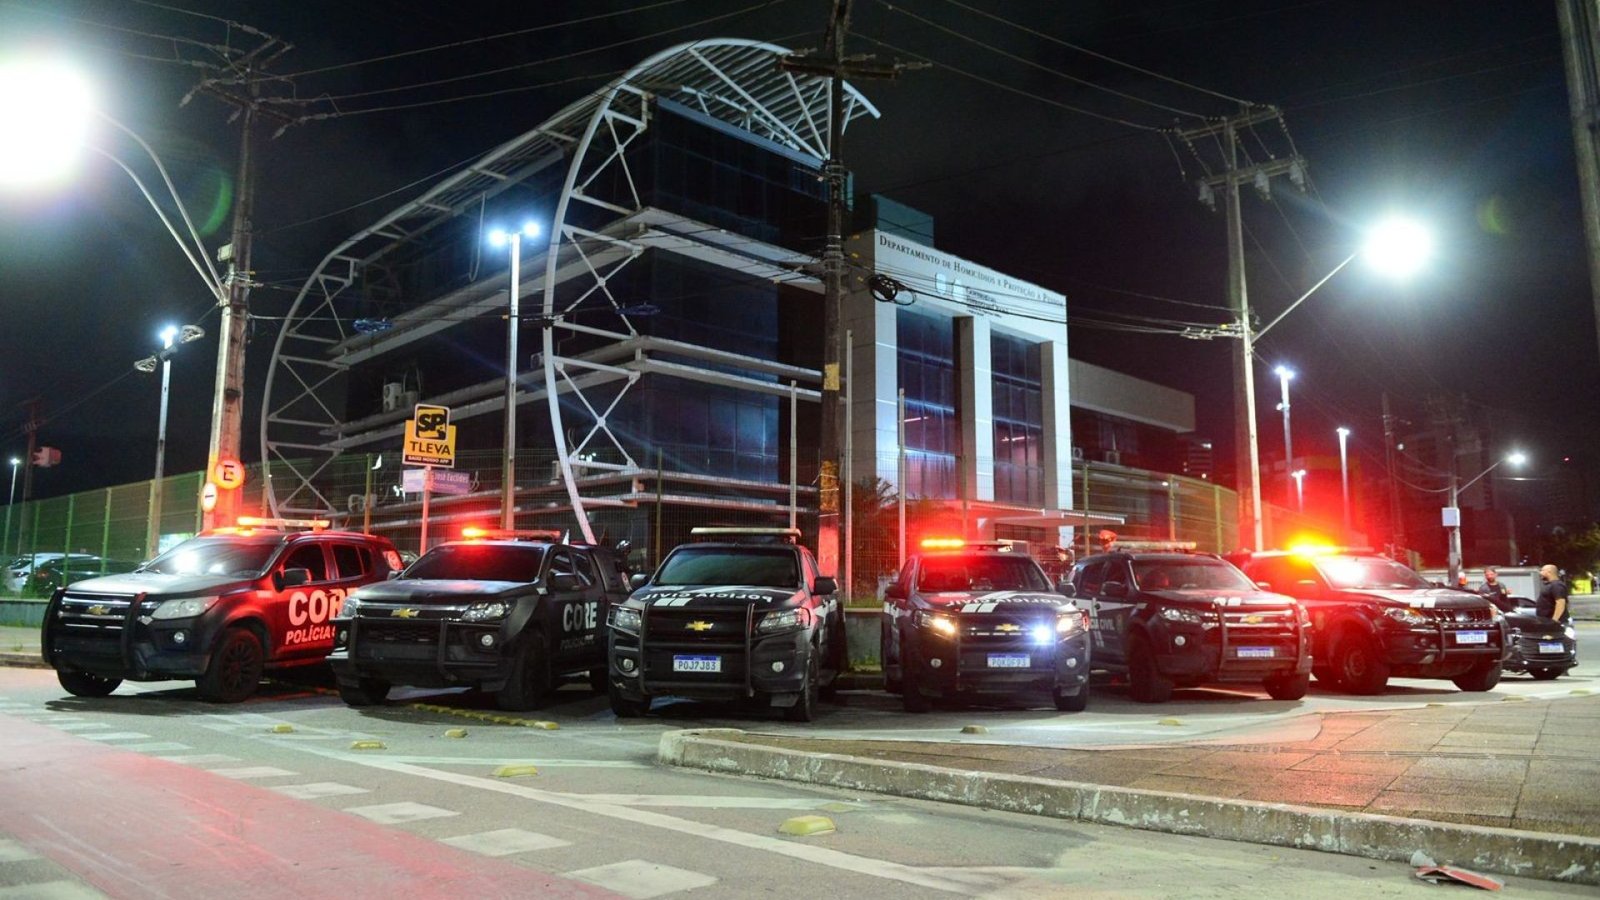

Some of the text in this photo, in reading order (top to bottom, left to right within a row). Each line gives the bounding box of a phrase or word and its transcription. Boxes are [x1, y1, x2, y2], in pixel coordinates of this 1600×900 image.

[879, 235, 940, 266] DEPARTAMENTO
[410, 440, 451, 456] TLEVA
[563, 602, 597, 632] CORE
[285, 624, 331, 645] POLÍCIA
